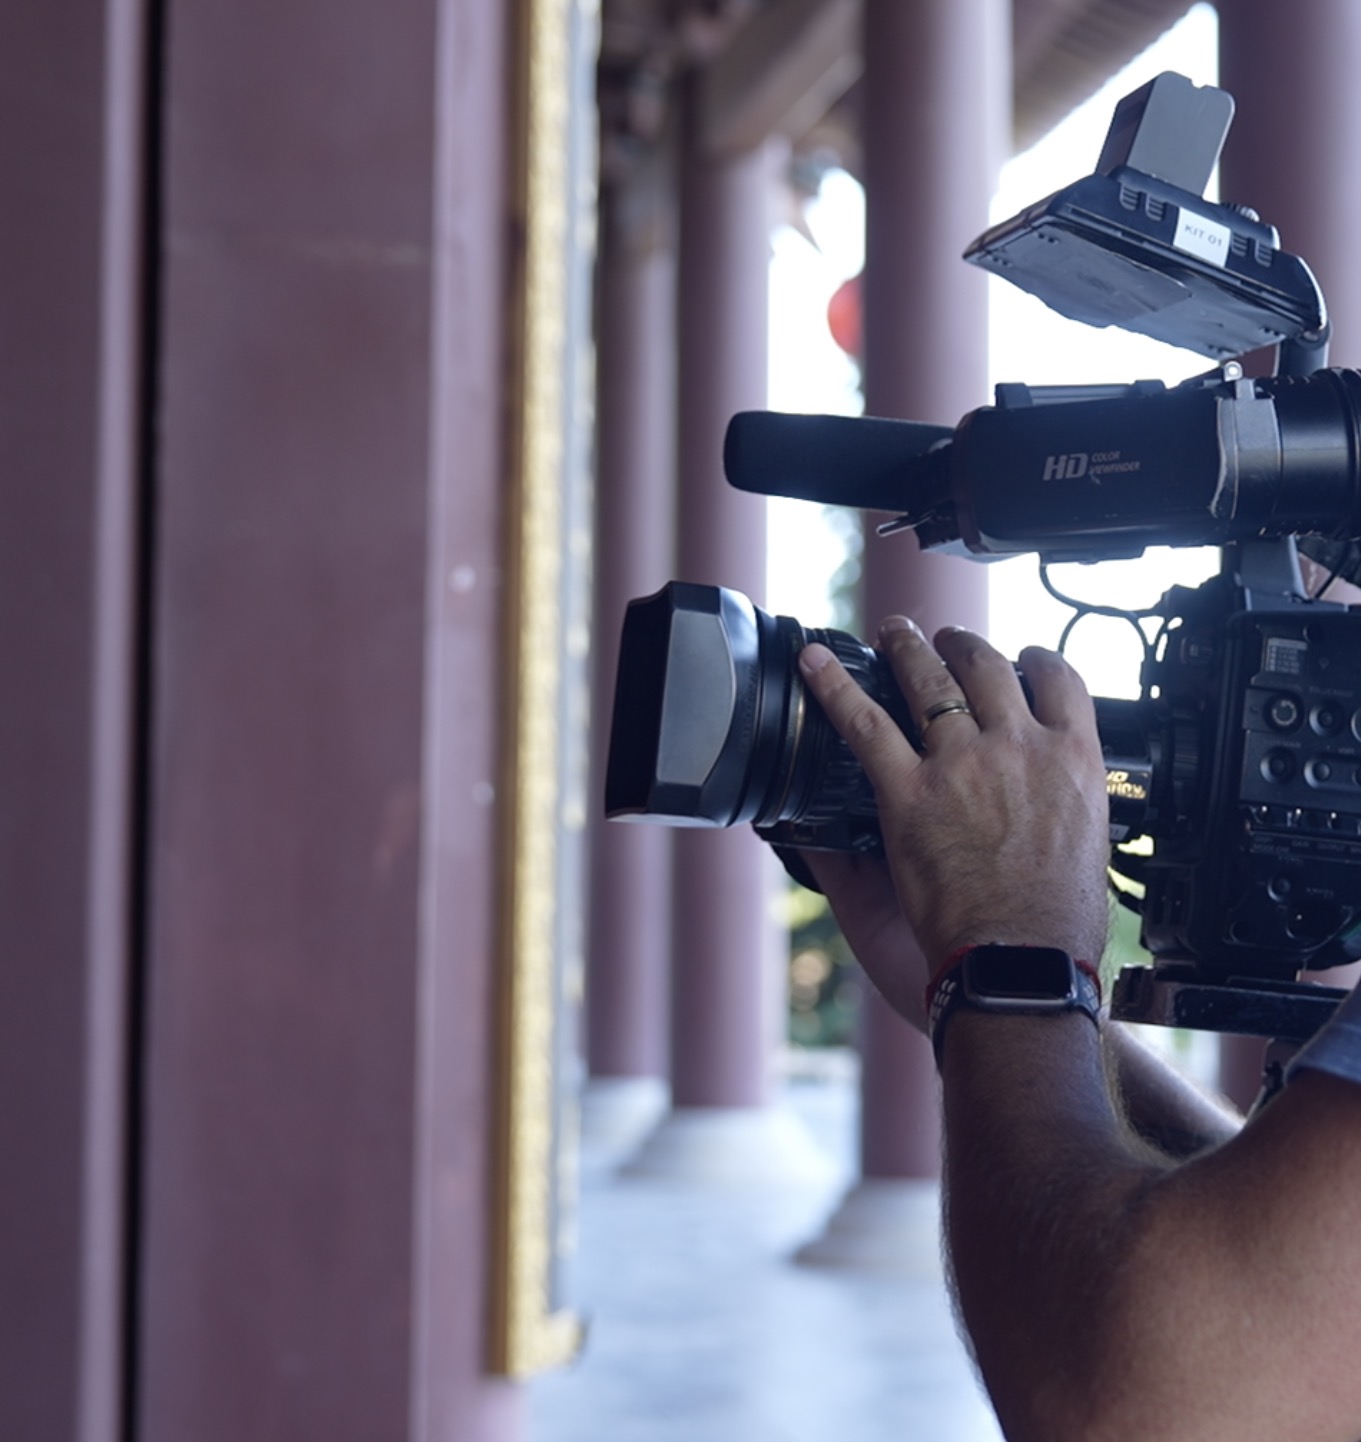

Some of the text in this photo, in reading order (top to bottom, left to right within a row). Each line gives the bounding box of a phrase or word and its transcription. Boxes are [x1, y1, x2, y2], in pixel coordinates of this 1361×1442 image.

[1184, 224, 1206, 239] KIT
[1091, 450, 1120, 462] COLOR
[1043, 453, 1088, 481] HD
